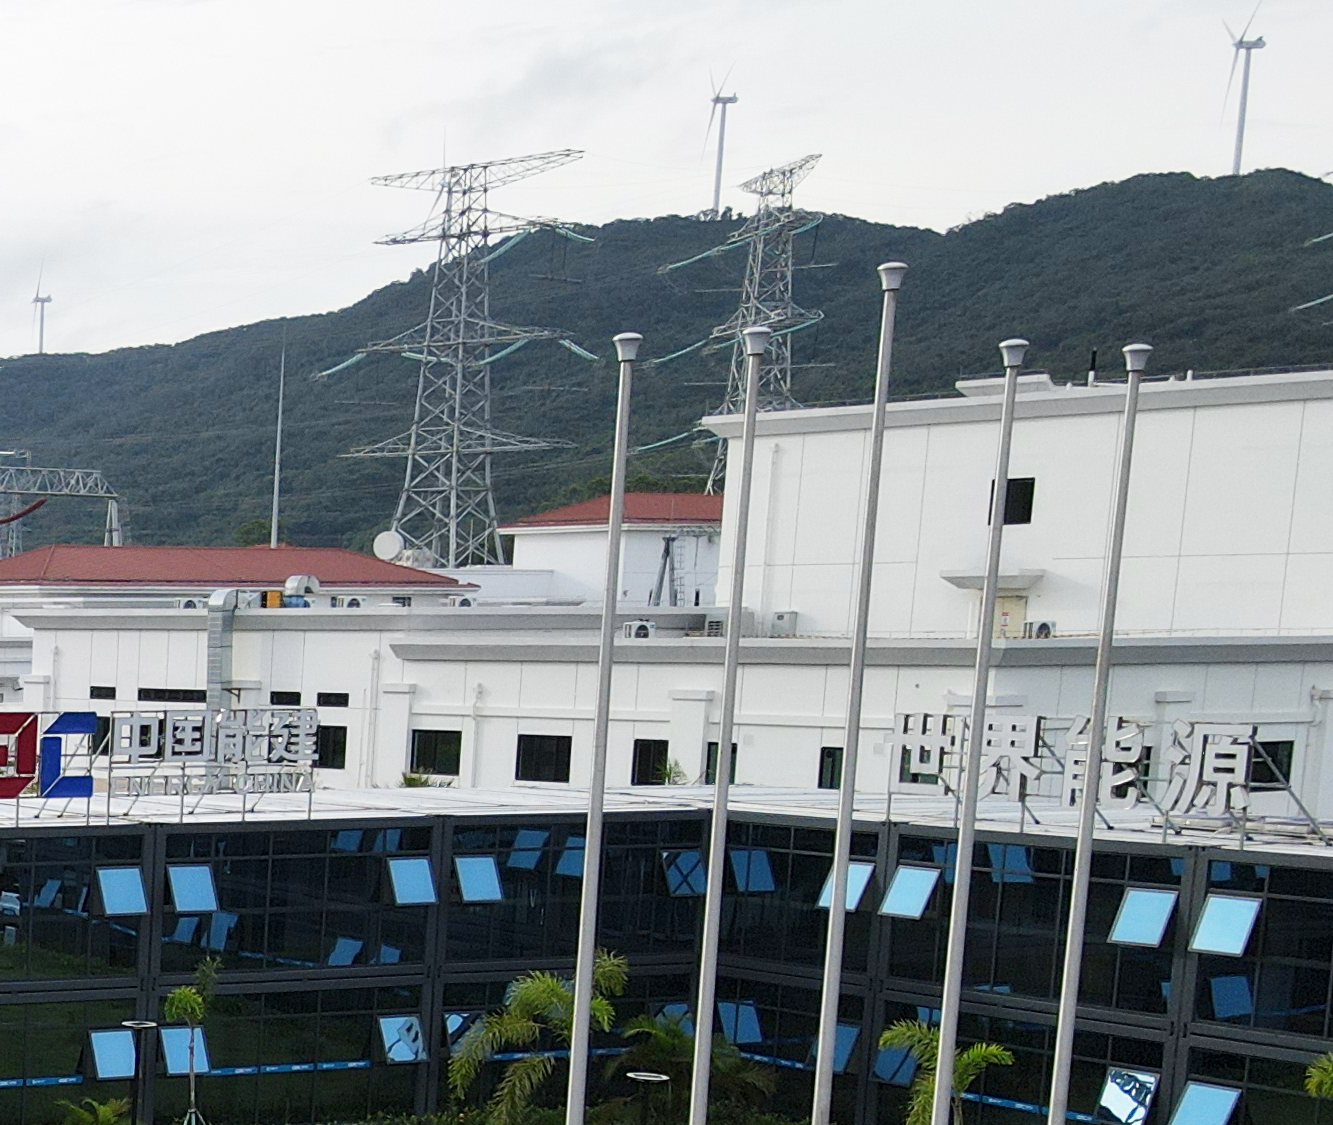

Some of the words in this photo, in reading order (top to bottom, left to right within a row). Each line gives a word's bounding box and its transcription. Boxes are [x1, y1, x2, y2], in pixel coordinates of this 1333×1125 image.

[112, 708, 321, 765] 中国能建
[887, 711, 1259, 815] 世界能源
[110, 774, 223, 797] ENERGY
[233, 771, 316, 794] CHINA
